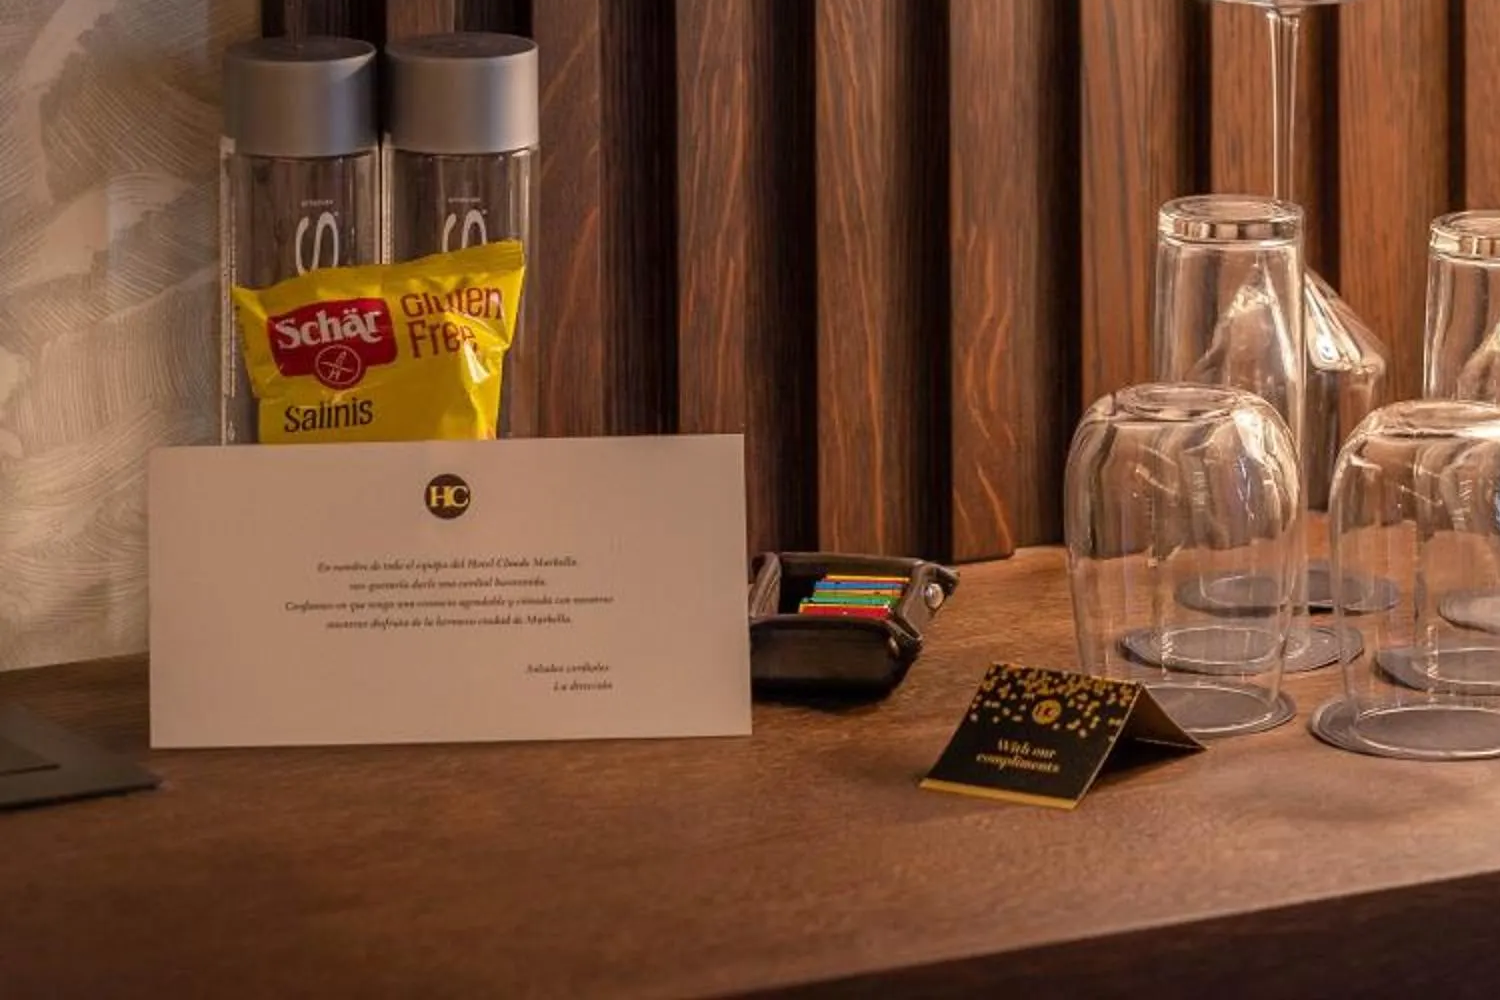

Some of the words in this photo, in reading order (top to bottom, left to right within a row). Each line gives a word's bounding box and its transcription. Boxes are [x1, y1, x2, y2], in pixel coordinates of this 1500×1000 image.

[401, 286, 504, 320] Gluten
[274, 306, 384, 349] Schär
[408, 319, 477, 359] Free
[284, 398, 373, 434] Salinis
